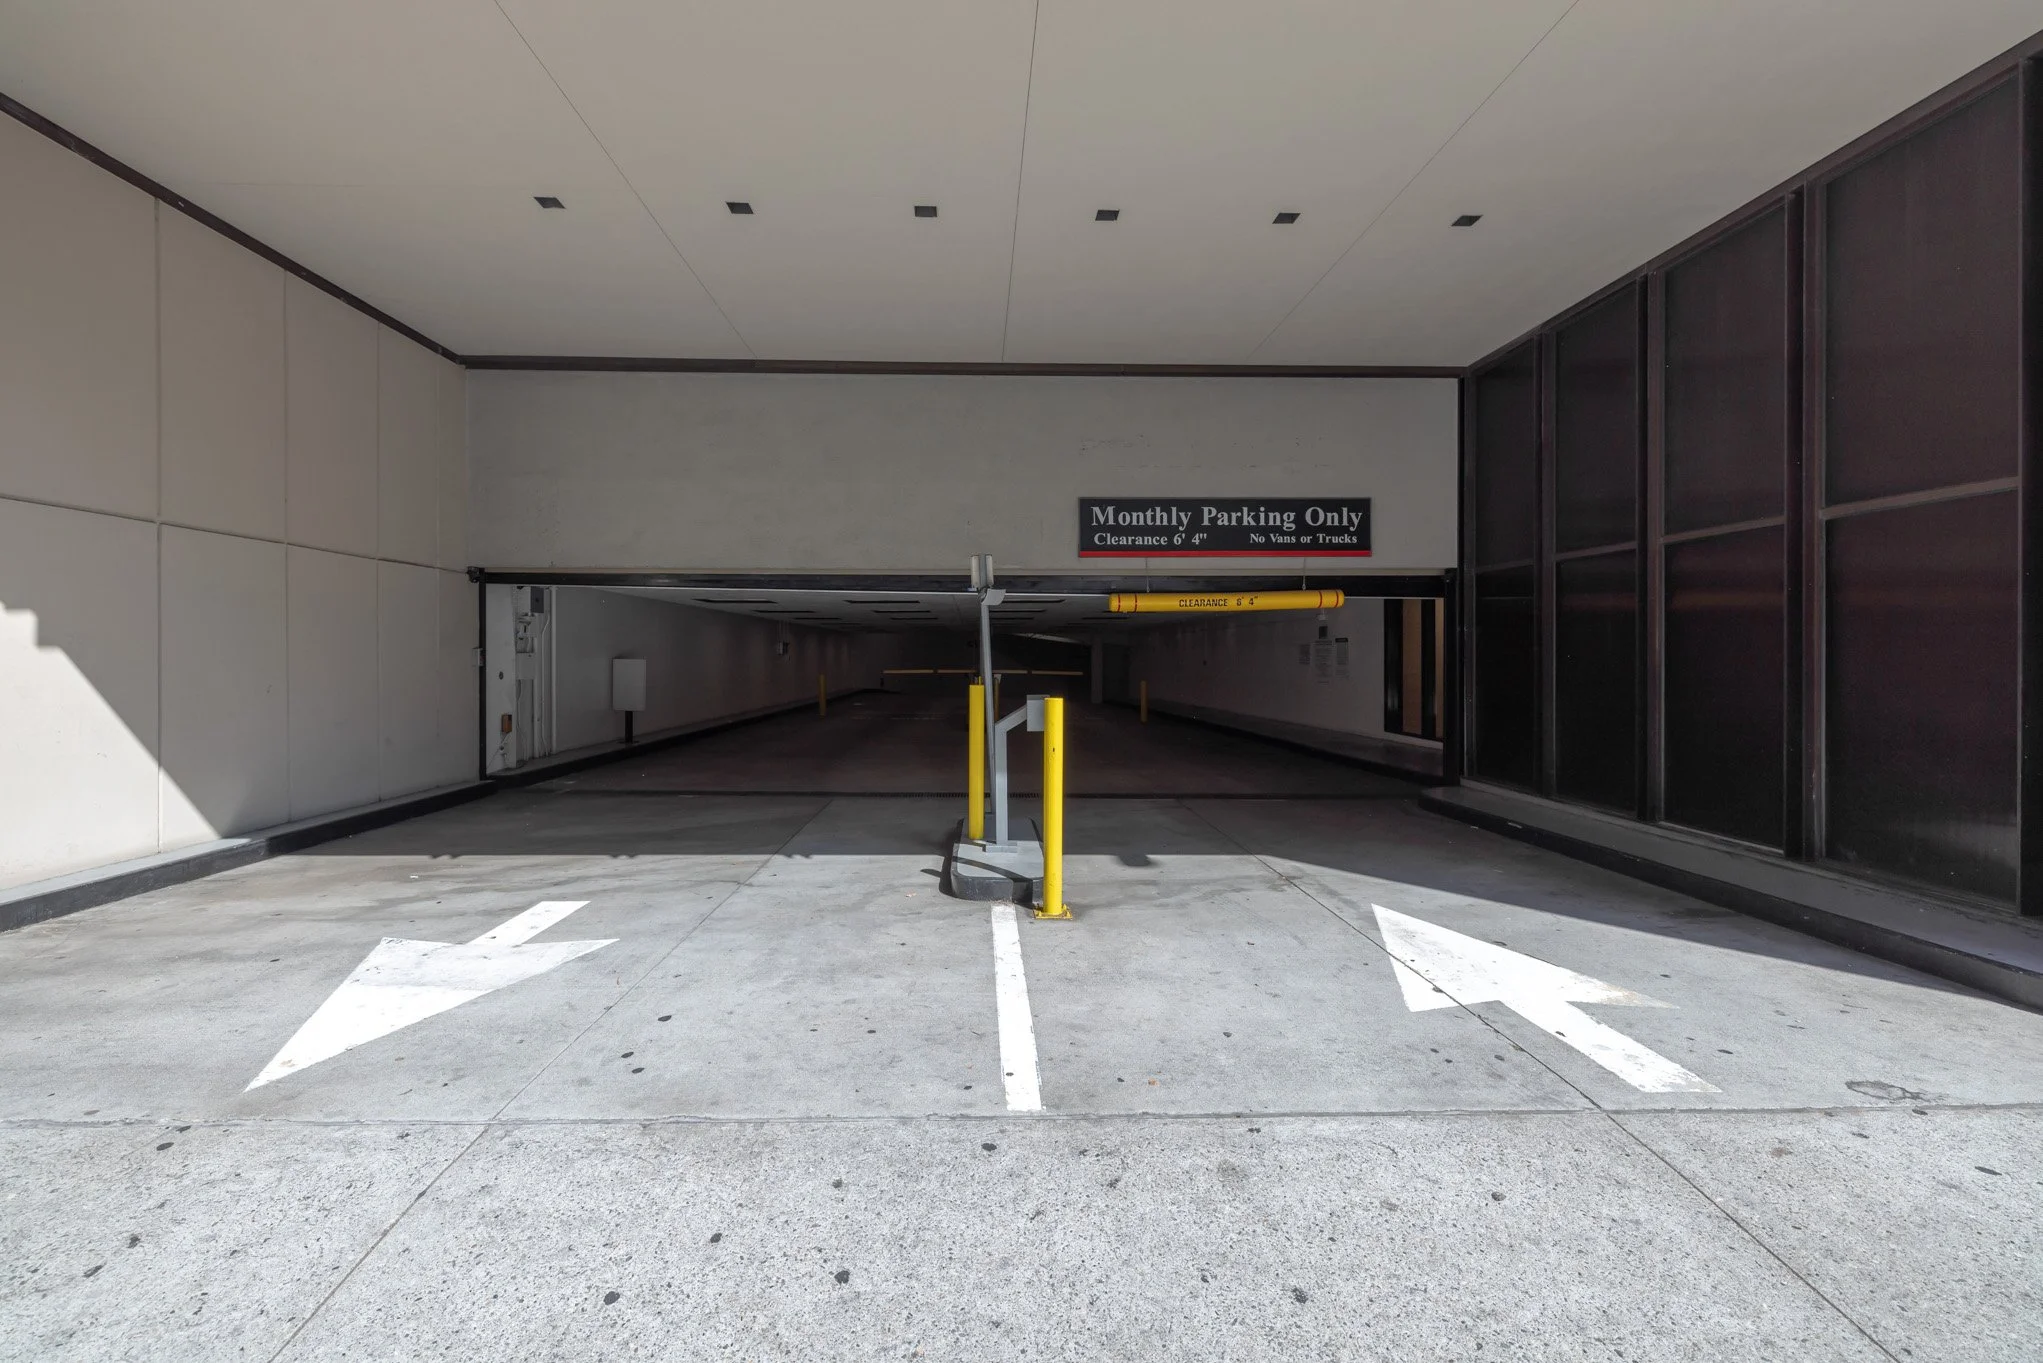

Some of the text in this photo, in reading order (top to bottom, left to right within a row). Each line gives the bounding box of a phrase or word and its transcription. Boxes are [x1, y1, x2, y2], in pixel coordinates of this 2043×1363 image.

[1091, 505, 1363, 531] Monthly Parking Only
[1094, 532, 1168, 545] Clearance
[1250, 533, 1358, 543] No Vans or Trucks
[1179, 598, 1228, 608] CLEARANCE
